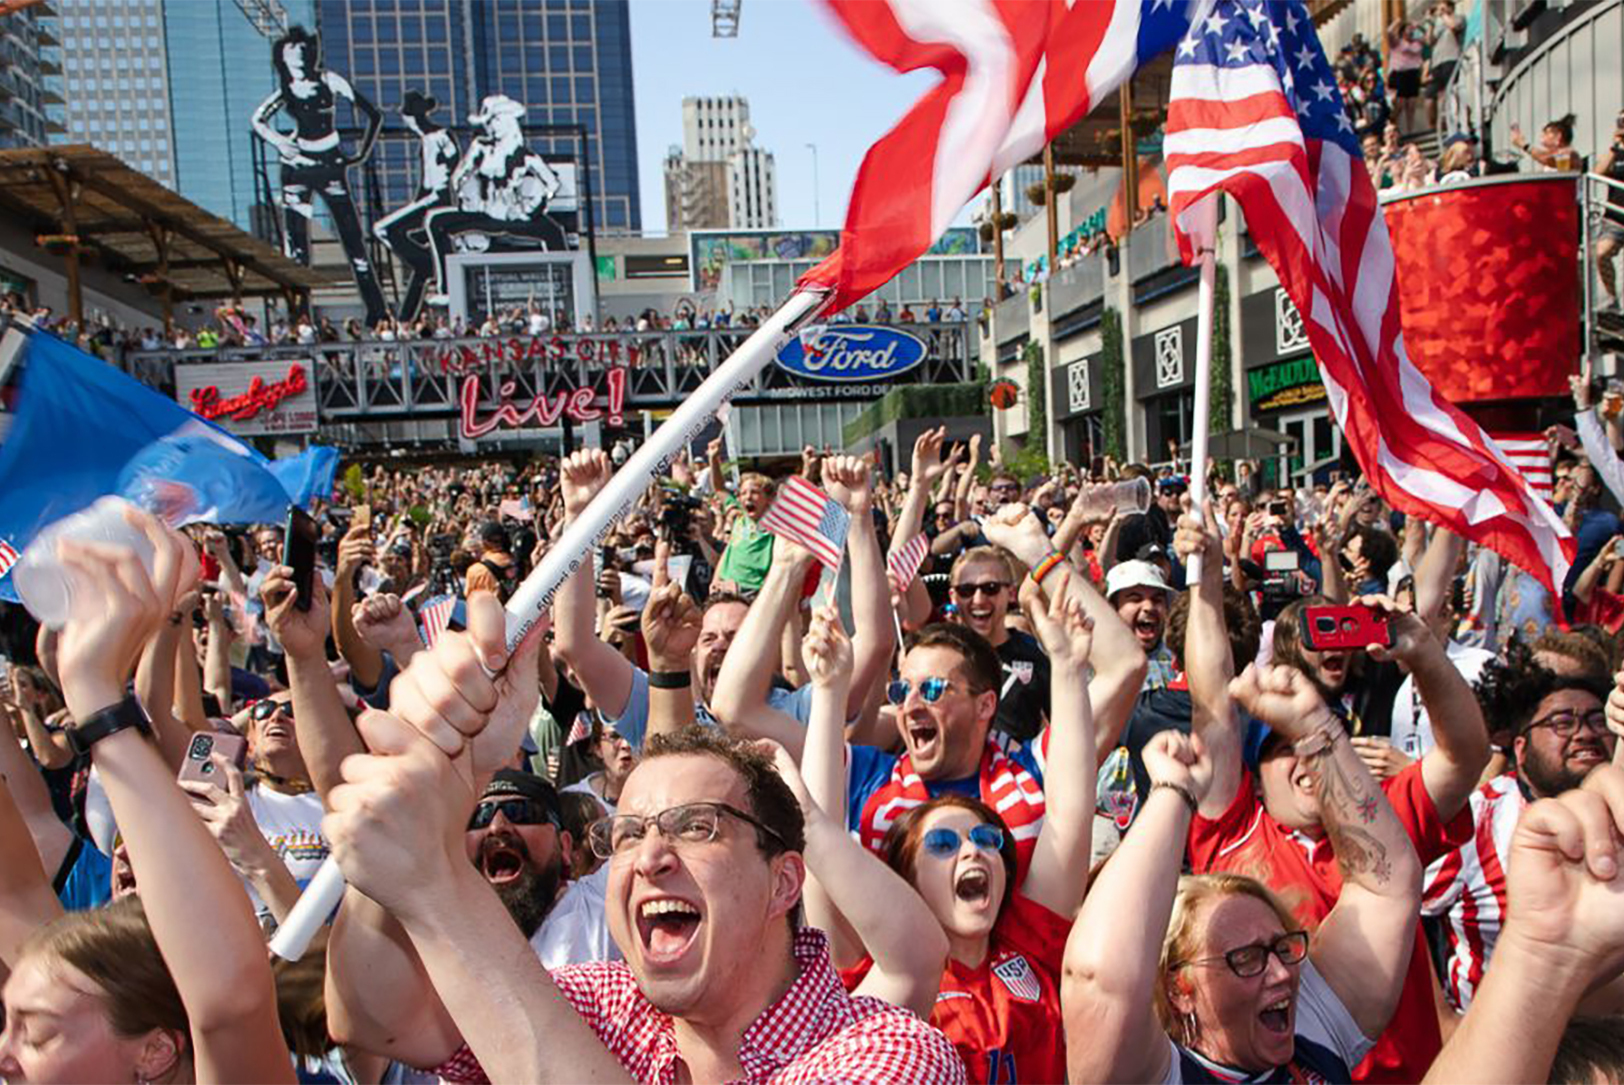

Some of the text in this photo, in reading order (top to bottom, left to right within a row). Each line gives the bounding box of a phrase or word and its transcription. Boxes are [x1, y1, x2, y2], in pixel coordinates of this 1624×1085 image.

[441, 336, 565, 372] KANSAS
[803, 331, 898, 371] Ford
[462, 369, 625, 437] Live!
[771, 386, 832, 398] MIDWEST
[835, 385, 871, 396] FORD
[998, 957, 1027, 977] USA
